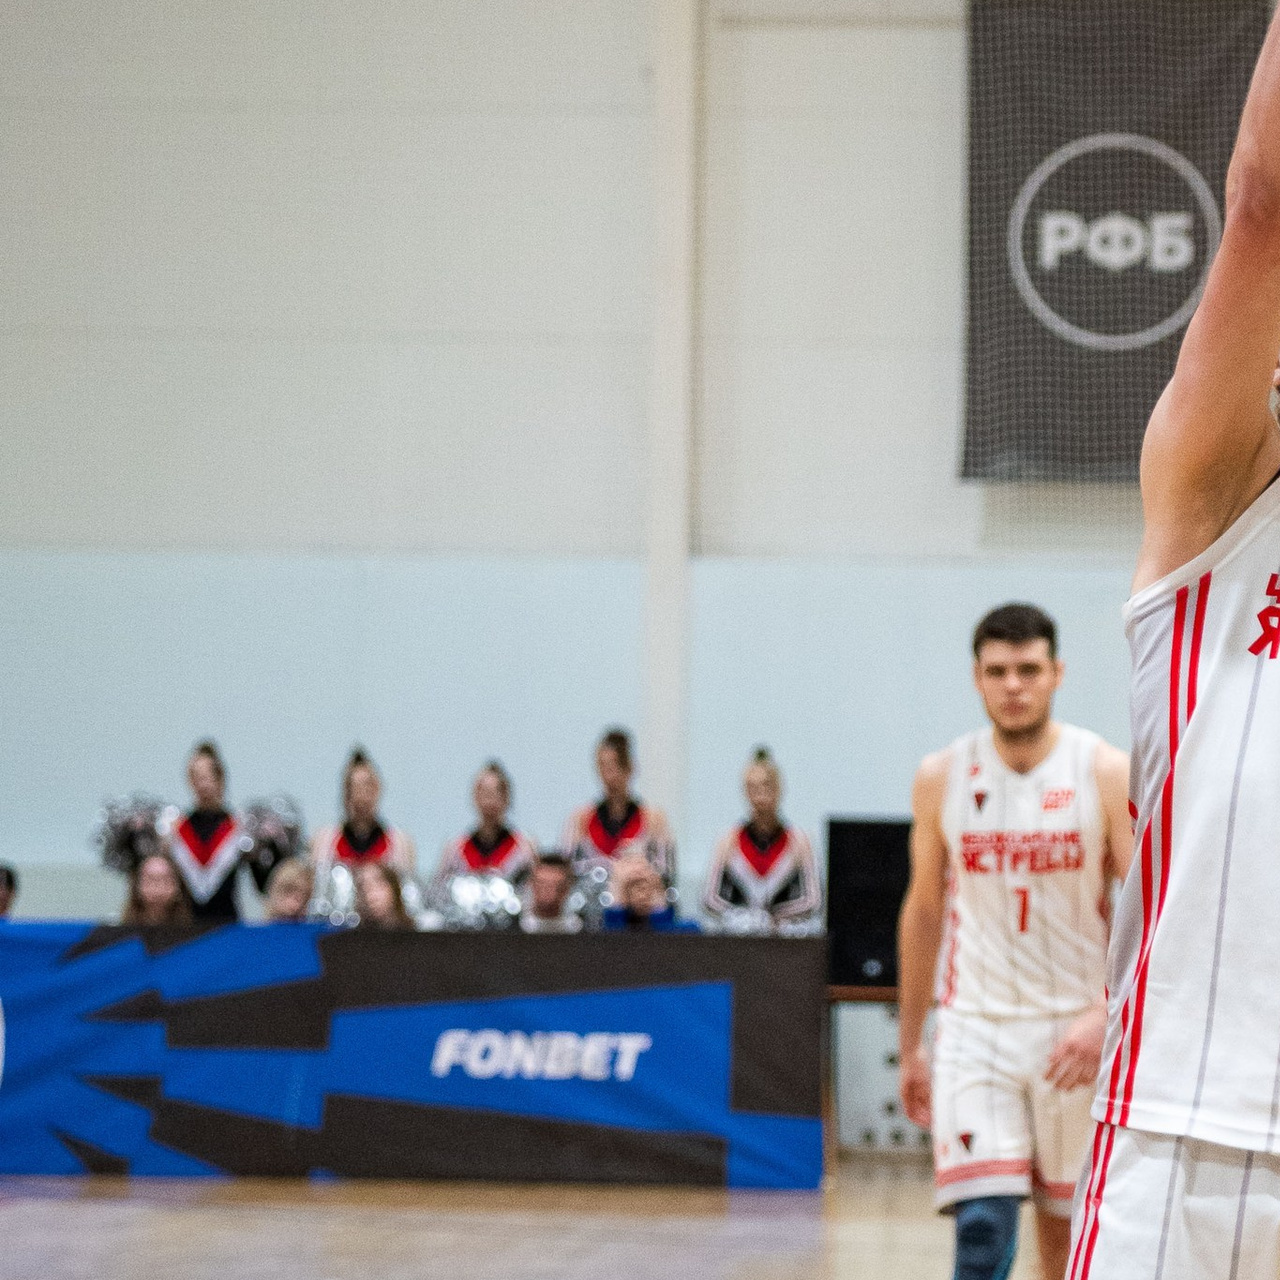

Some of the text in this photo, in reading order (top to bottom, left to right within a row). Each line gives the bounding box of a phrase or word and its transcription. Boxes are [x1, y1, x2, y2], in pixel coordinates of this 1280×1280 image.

[1041, 210, 1195, 272] РФБ
[1014, 887, 1030, 934] 1
[432, 1029, 652, 1081] FONBET
